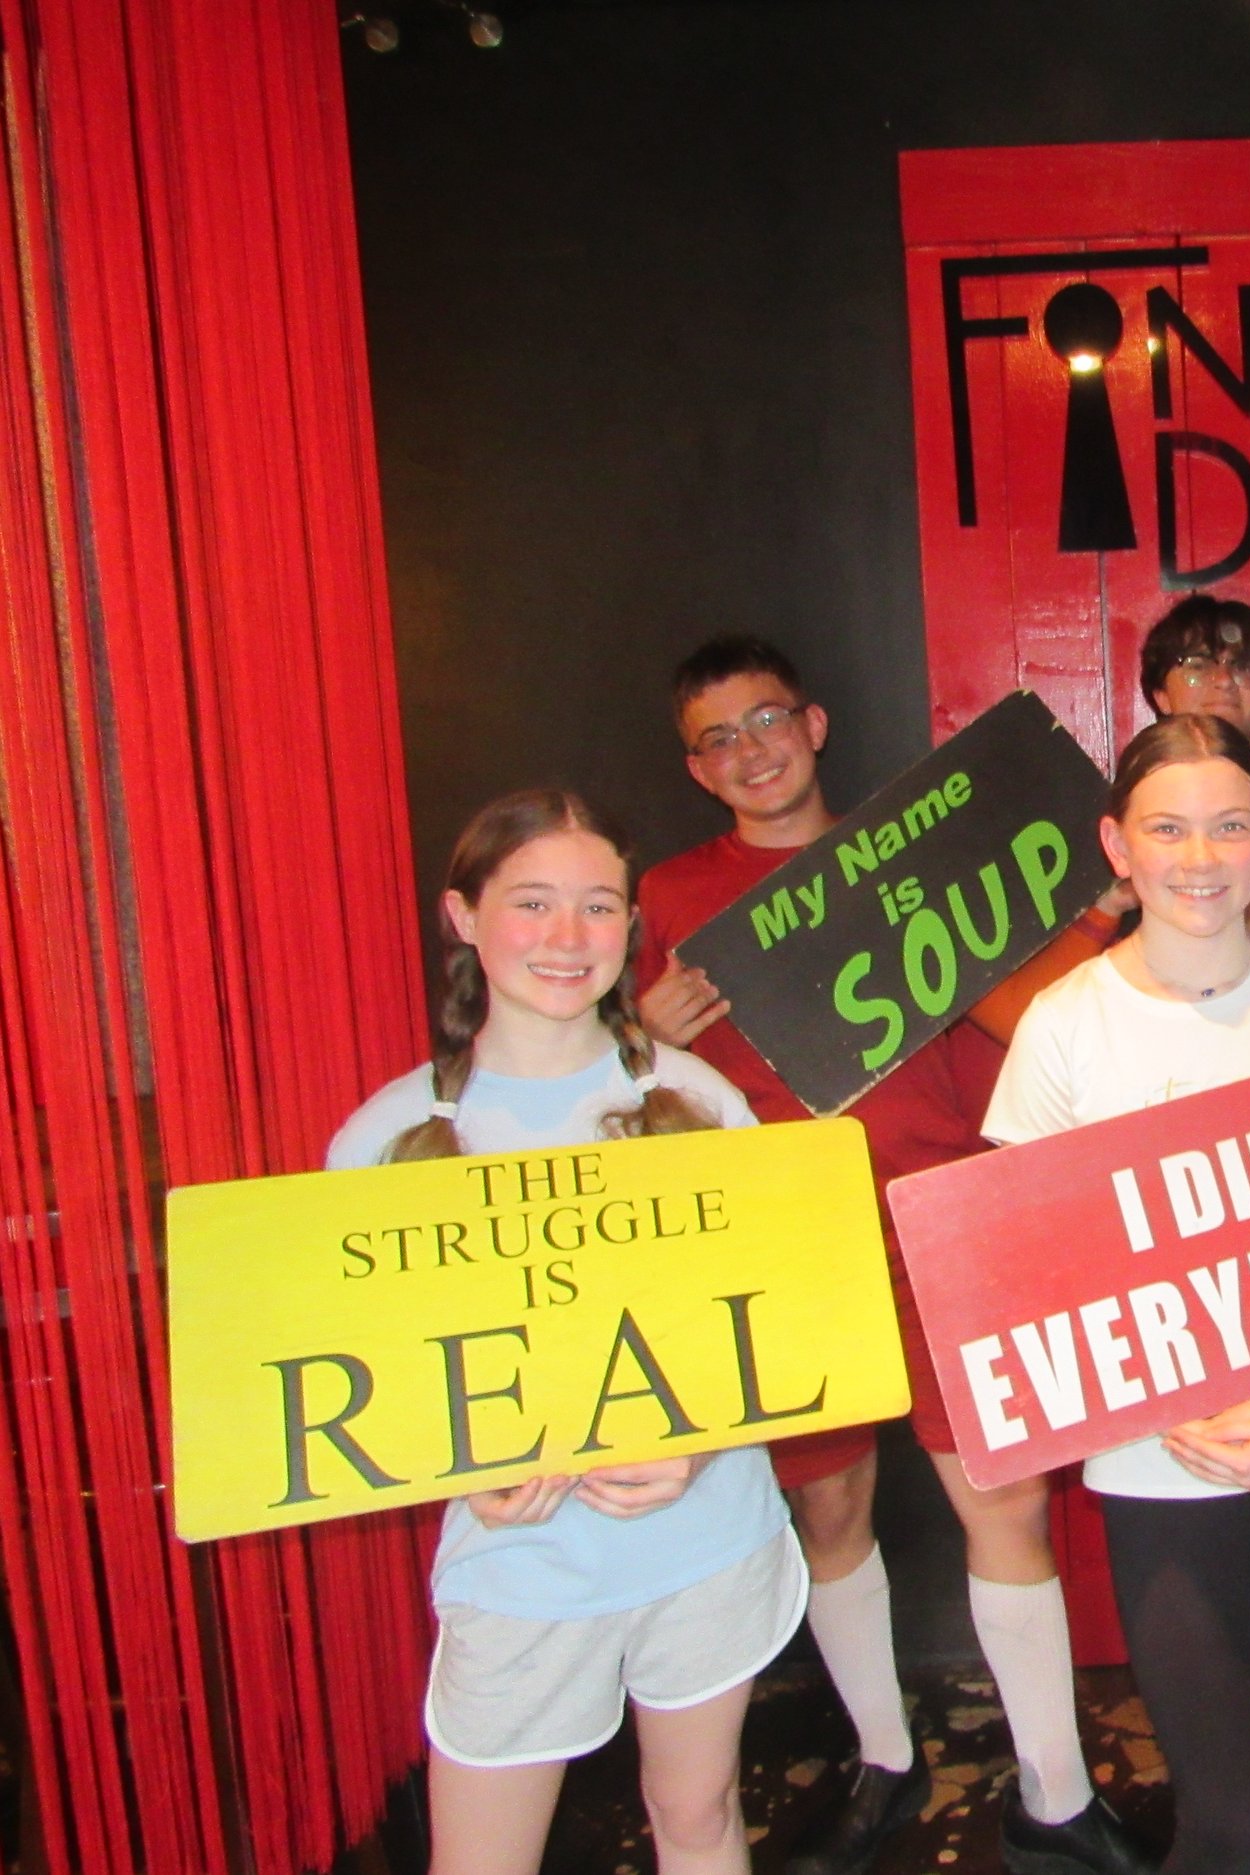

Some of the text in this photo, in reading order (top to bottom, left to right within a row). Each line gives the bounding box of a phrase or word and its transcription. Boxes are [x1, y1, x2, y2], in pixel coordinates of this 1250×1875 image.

[750, 771, 973, 950] My Name
[877, 876, 924, 927] is
[833, 820, 1070, 1071] SOUP
[466, 1152, 608, 1208] THE
[1112, 1167, 1154, 1253] I
[341, 1189, 731, 1280] STRUGGLE
[521, 1260, 580, 1310] IS
[260, 1290, 828, 1510] REAL
